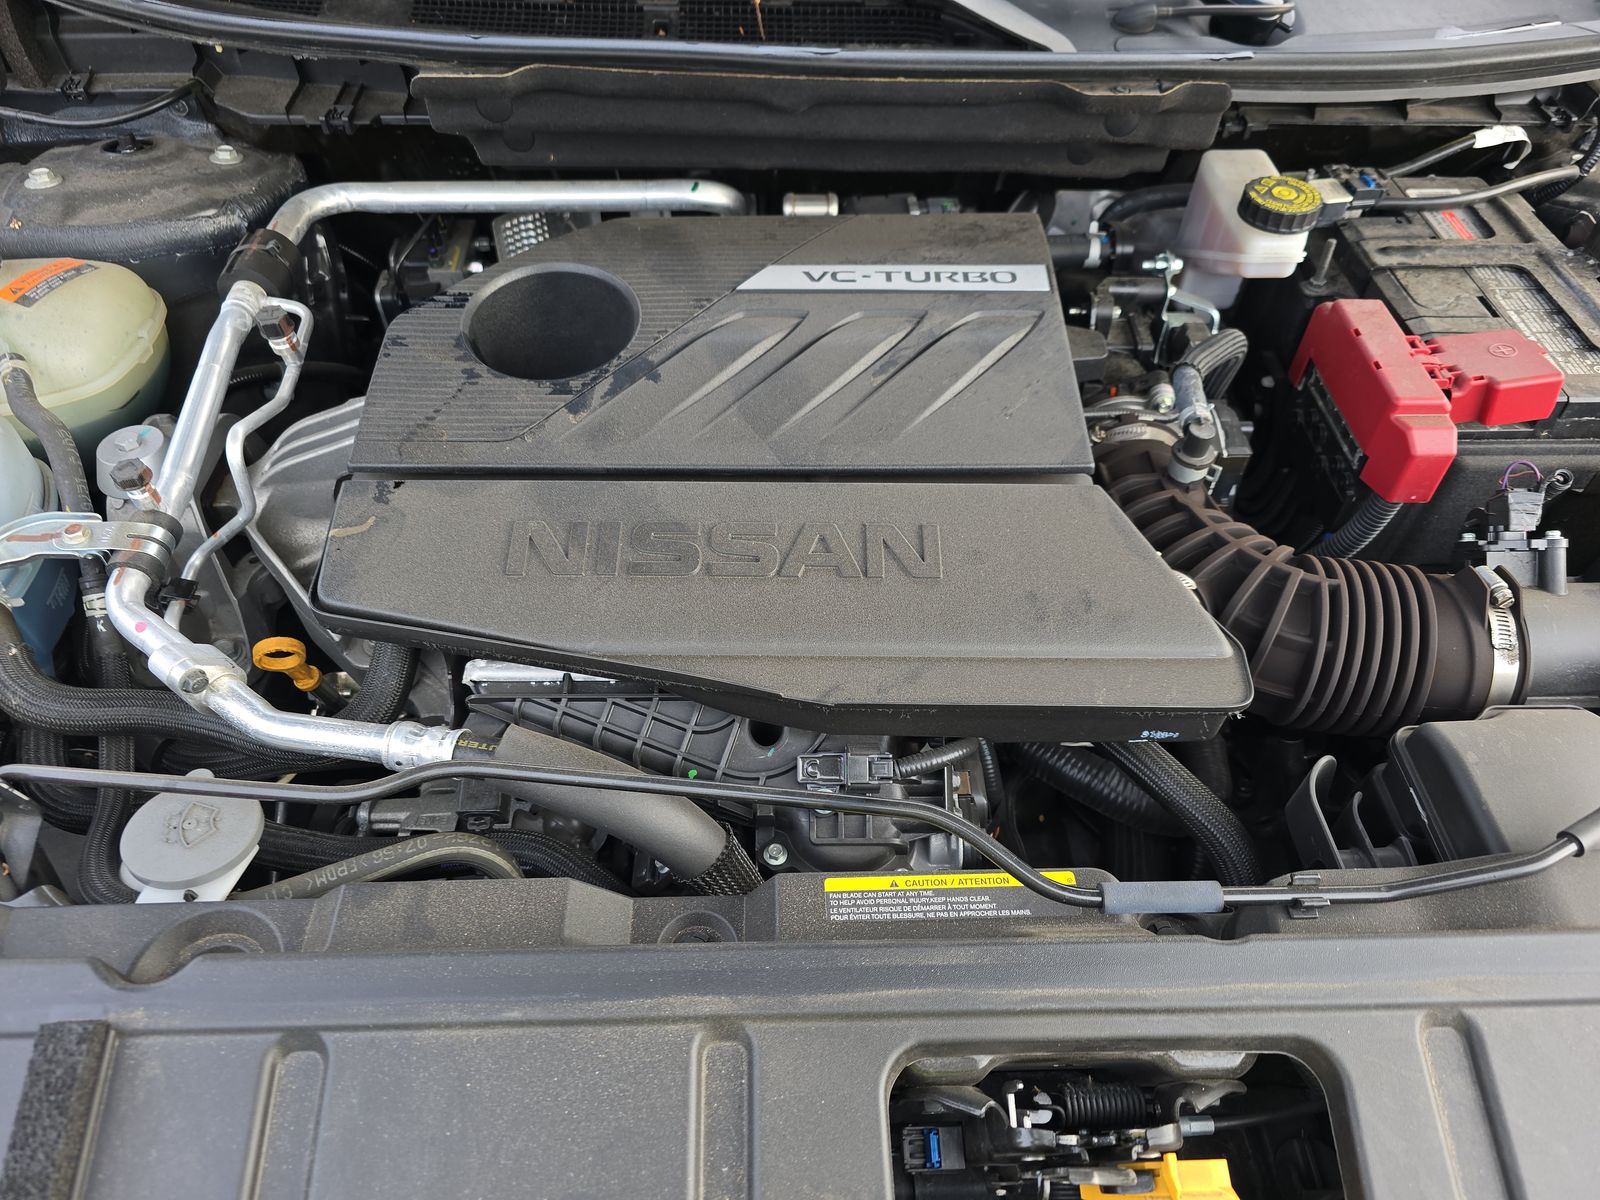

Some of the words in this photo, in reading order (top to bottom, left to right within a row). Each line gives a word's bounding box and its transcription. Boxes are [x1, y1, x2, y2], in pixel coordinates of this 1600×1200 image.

[802, 270, 1017, 284] VC-TURBO
[505, 520, 943, 579] NISSAN
[904, 879, 947, 887] CAUTION
[950, 878, 955, 886] /
[958, 877, 1010, 885] ATTENTION
